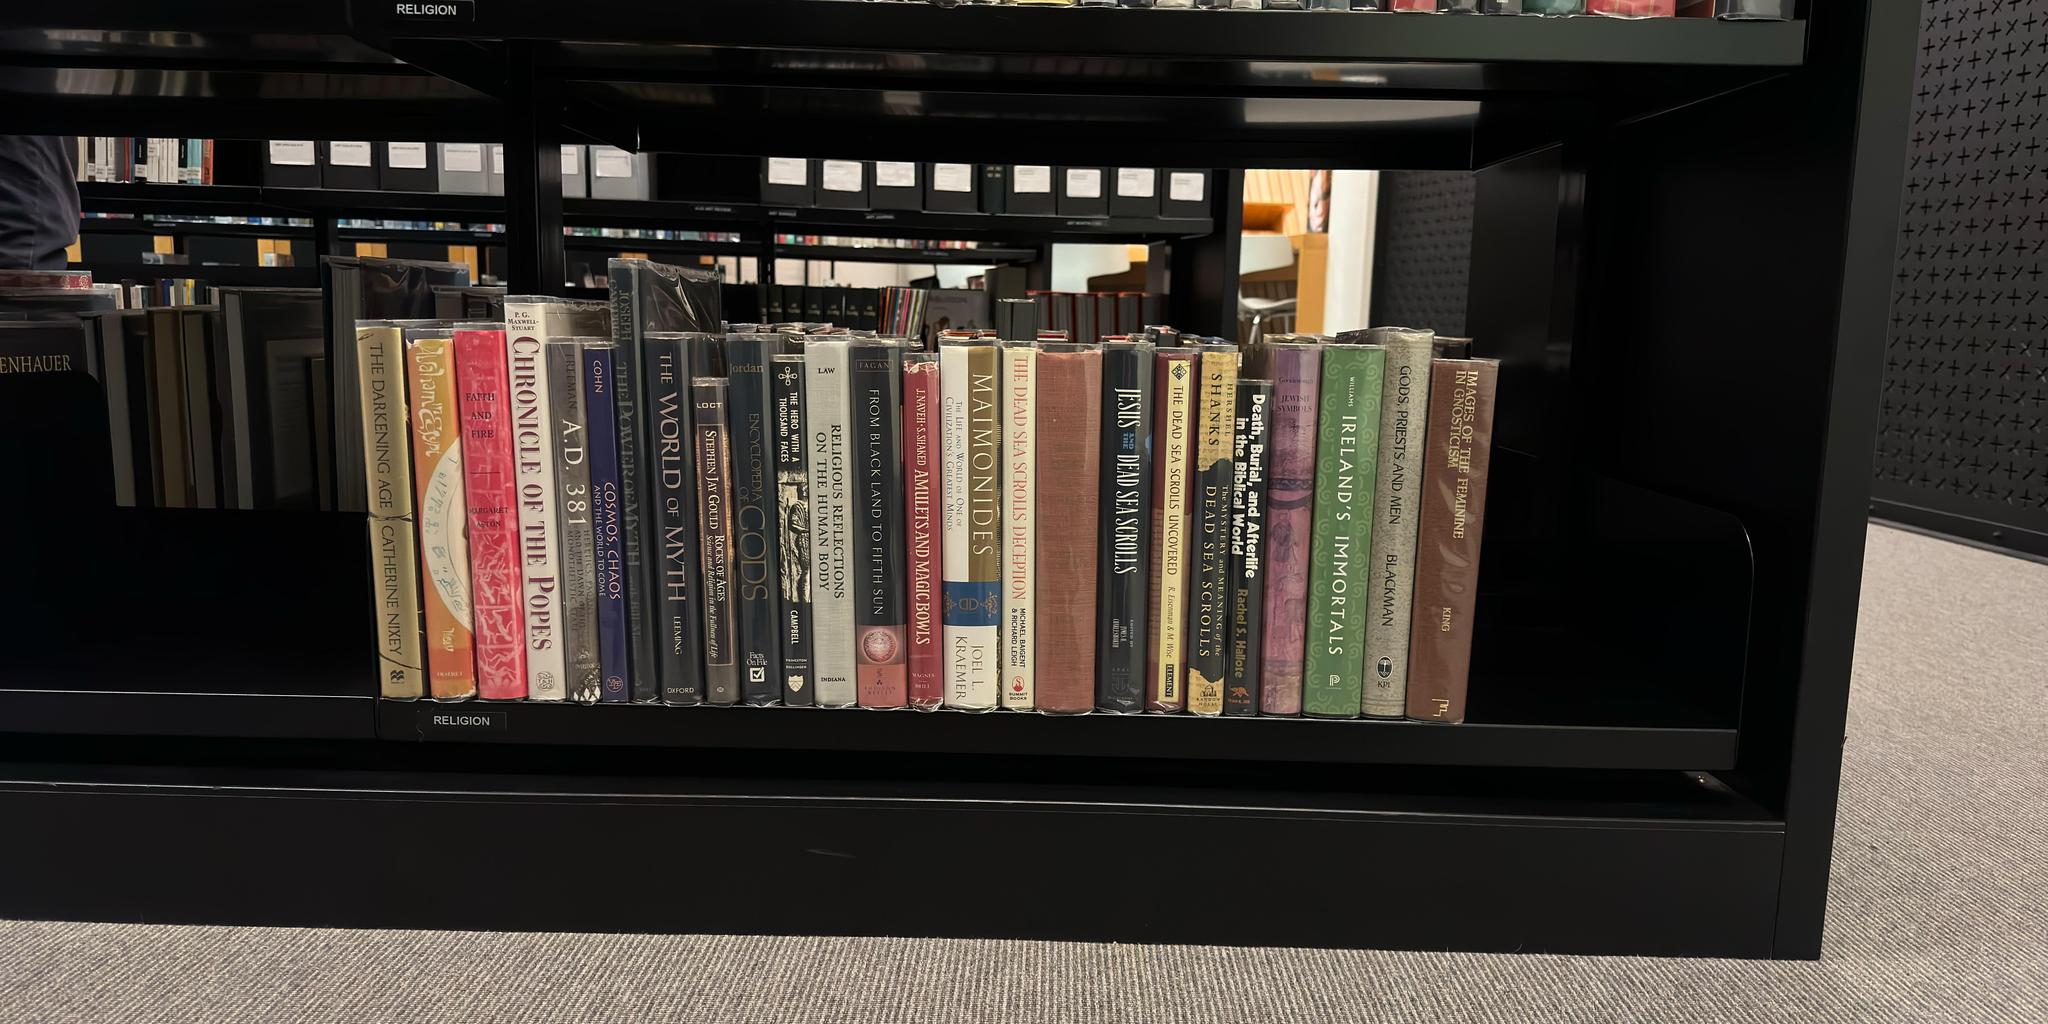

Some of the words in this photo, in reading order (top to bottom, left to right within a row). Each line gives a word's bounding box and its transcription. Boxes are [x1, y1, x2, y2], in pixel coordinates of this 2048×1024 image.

[396, 3, 457, 16] RELIGION
[619, 290, 633, 341] JOSEPH
[370, 343, 384, 375] THE
[592, 359, 604, 394] COHN
[660, 352, 673, 385] THE
[859, 361, 890, 369] FAGAN
[1014, 356, 1028, 383] THE
[565, 352, 579, 411] FREEMAN
[616, 361, 630, 398] THE
[1348, 376, 1356, 407] WILLIAMS
[1397, 365, 1411, 407] GODS,
[1455, 370, 1468, 384] IN
[465, 393, 495, 402] FAITH
[512, 336, 541, 474] CHRONICLE
[789, 392, 798, 405] THE
[869, 389, 881, 427] FROM
[955, 401, 963, 413] THE
[1014, 387, 1028, 427] DEAD
[1114, 388, 1142, 429] JESUS
[1173, 386, 1184, 405] THE
[1208, 373, 1223, 446] SHANKS
[1224, 383, 1235, 438] HERSHEL
[1462, 370, 1479, 422] IMAGES
[371, 380, 391, 474] DARKENING
[471, 412, 492, 421] AND
[779, 397, 788, 437] THOUSAND
[790, 410, 799, 430] HERO
[945, 396, 955, 457] CIVILIZATION'S
[955, 416, 965, 431] LIFE
[1172, 410, 1183, 439] DEAD
[1235, 417, 1250, 430] in
[1249, 394, 1266, 441] Death,
[1447, 388, 1465, 469] GNOSTICISM
[1461, 425, 1473, 443] OF
[471, 430, 494, 440] FIRE
[562, 418, 584, 472] A.D.
[617, 400, 635, 477] POWER
[659, 392, 682, 488] WORLD
[705, 430, 718, 474] STEPHEN
[780, 441, 789, 463] FACES
[791, 434, 800, 453] WITH
[816, 431, 827, 453] ON
[955, 434, 964, 450] AND
[1013, 431, 1028, 458] SEA
[1235, 434, 1249, 457] the
[1393, 410, 1409, 470] PRIESTS
[749, 413, 763, 502] ENCYCLOPEDIA
[831, 424, 844, 500] RELIGIOUS
[870, 433, 882, 477] BLACK
[956, 452, 965, 482] WORLD
[972, 373, 994, 555] MAIMONIDES
[1116, 454, 1141, 487] DEAD
[1170, 444, 1182, 463] SEA
[1246, 444, 1264, 487] Burial,
[1336, 415, 1357, 521] IRELAND'S
[1457, 447, 1472, 474] THE
[624, 479, 636, 501] OF
[705, 476, 719, 493] JAY
[817, 459, 828, 488] THE
[946, 461, 955, 499] GREATEST
[1168, 468, 1181, 510] SCROLLS
[1232, 461, 1248, 509] Biblical
[1391, 473, 1404, 491] AND
[379, 480, 393, 509] AGE
[522, 483, 544, 513] OF
[566, 483, 588, 526] 381
[594, 485, 602, 505] AND
[666, 497, 680, 517] OF
[739, 487, 750, 502] OF
[871, 482, 883, 519] LAND
[914, 469, 930, 530] AMULETS
[956, 498, 965, 516] ONE
[1012, 462, 1028, 521] SCROLLS
[1115, 491, 1140, 515] SEA
[1221, 486, 1229, 501] The
[1247, 490, 1261, 517] and
[1452, 477, 1469, 539] FEMININE
[469, 506, 508, 514] MARGARET
[595, 508, 603, 524] THE
[604, 482, 617, 546] COSMOS,
[708, 495, 720, 530] GOULD
[818, 494, 829, 547] HUMAN
[946, 503, 955, 532] MINDS
[1204, 485, 1217, 534] DEAD
[1389, 495, 1402, 525] MEN
[526, 521, 548, 567] THE
[596, 526, 605, 557] WORLD
[626, 502, 641, 567] MYTH
[706, 535, 715, 559] Science
[872, 523, 883, 542] TO
[916, 531, 930, 557] AND
[1113, 517, 1140, 575] SCROLLS
[1166, 514, 1179, 575] UNCOVERED
[1219, 504, 1229, 555] MYSTERY
[1231, 513, 1246, 555] World
[598, 559, 606, 570] TO
[665, 526, 687, 601] MYTH
[714, 535, 726, 563] ROCKS
[739, 505, 767, 601] GODS
[833, 505, 845, 599] REFLECTIONS
[872, 547, 884, 584] FIFTH
[1012, 526, 1027, 601] DECEPTION
[1203, 542, 1215, 572] SEA
[1245, 521, 1260, 579] Afterlife
[381, 525, 398, 609] CATHERINE
[598, 572, 607, 596] COME
[607, 549, 621, 600] CHAOS
[706, 571, 718, 597] Religion
[716, 566, 725, 577] OF
[818, 553, 830, 592] BODY
[916, 559, 931, 600] MAGIC
[716, 580, 727, 602] AGES
[873, 589, 884, 616] SUN
[1215, 577, 1225, 630] MEANING
[1236, 588, 1249, 624] Rachel
[1328, 536, 1350, 656] IMMORTALS
[1381, 554, 1398, 627] BLACKMAN
[528, 576, 555, 651] POPES
[790, 609, 800, 645] CAMPBELL
[916, 602, 931, 645] BOWLS
[1167, 594, 1176, 625] Eisenman
[1199, 581, 1213, 657] SCROLLS
[1441, 607, 1452, 632] KING
[386, 613, 402, 655] NIXEY
[674, 616, 683, 655] LEEMING
[1236, 627, 1247, 637] S.
[970, 644, 985, 675] JOEL
[1010, 646, 1018, 667] LEIGH
[1166, 642, 1174, 658] Wise
[1234, 640, 1246, 679] Hallote
[955, 635, 969, 701] KRAEMER
[1165, 664, 1173, 697] ELEMENT
[1377, 680, 1391, 688] KPI
[971, 681, 985, 691] L.
[433, 715, 490, 726] RELIGION
